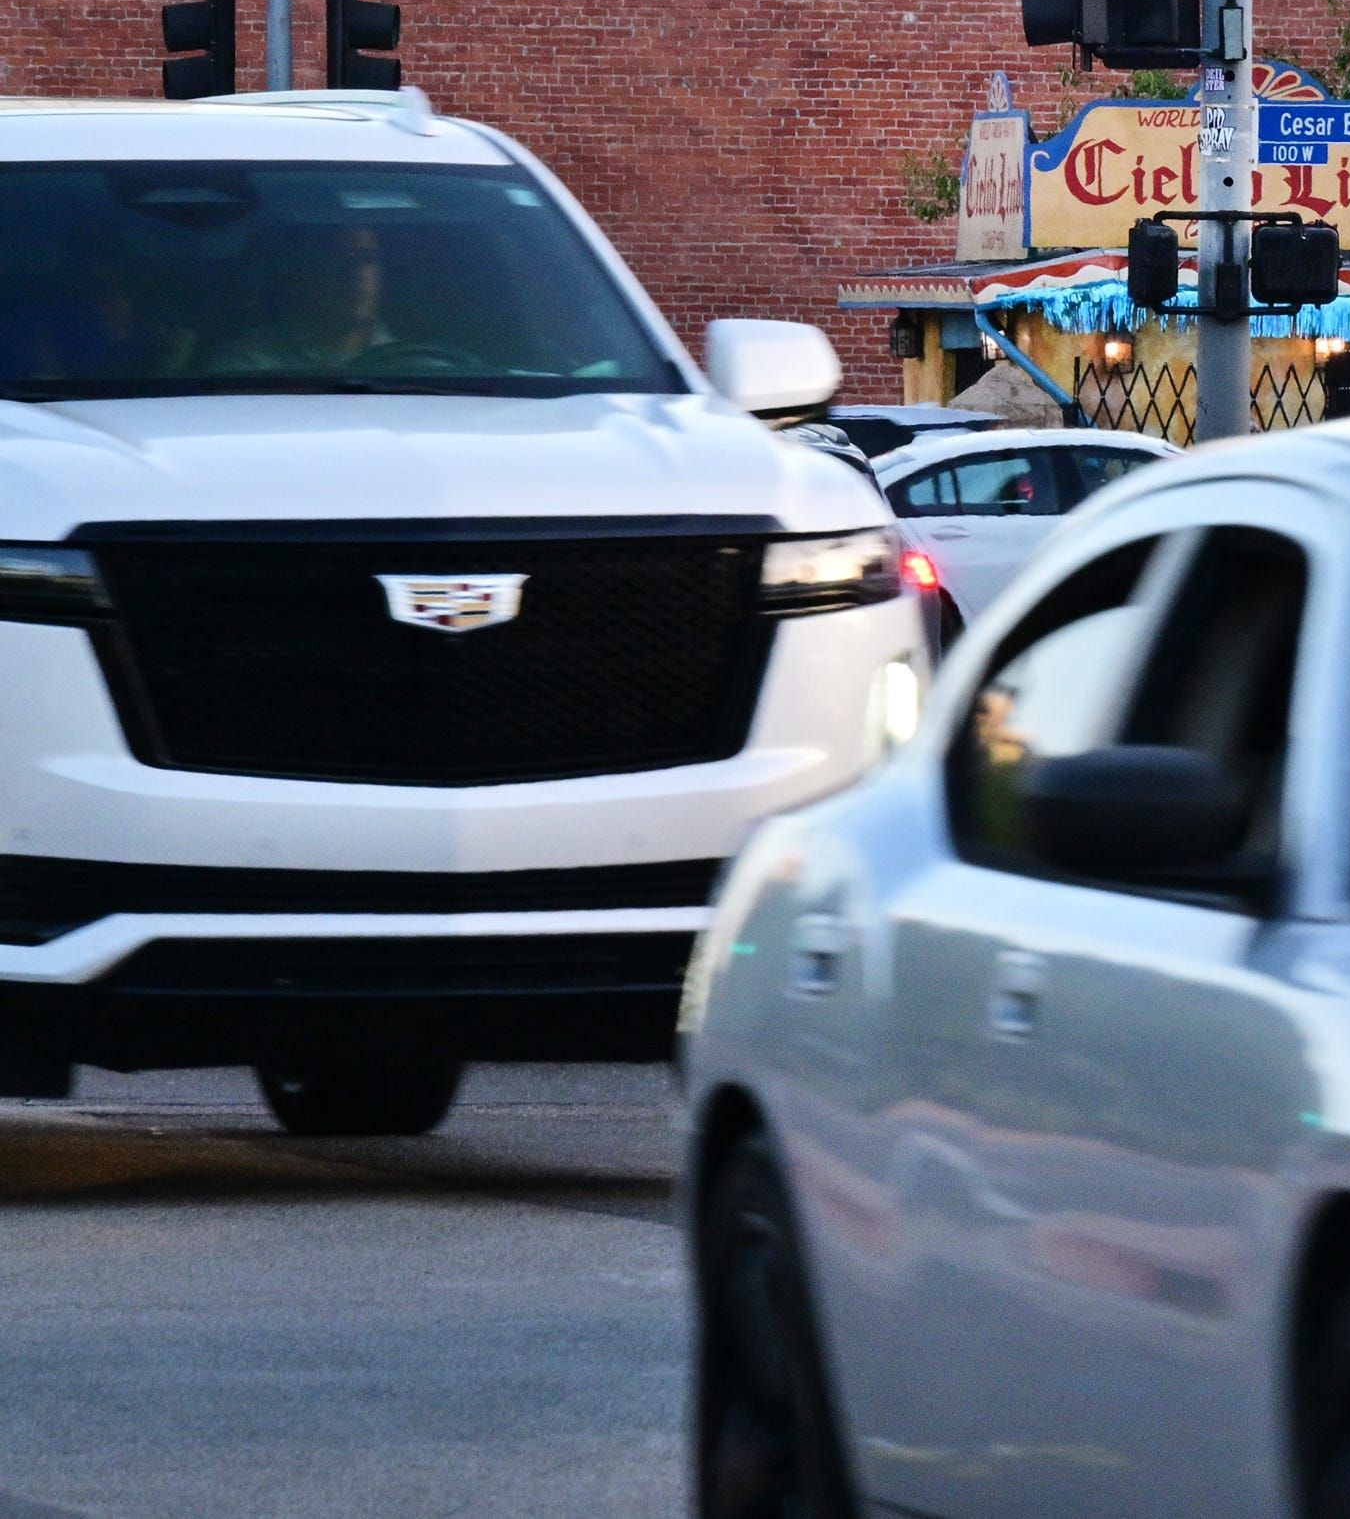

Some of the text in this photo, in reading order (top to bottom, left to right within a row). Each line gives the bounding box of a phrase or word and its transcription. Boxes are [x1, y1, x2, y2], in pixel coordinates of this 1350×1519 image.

[1280, 113, 1335, 137] Cesar
[1272, 145, 1314, 162] 100 W
[1064, 138, 1263, 207] Ciel
